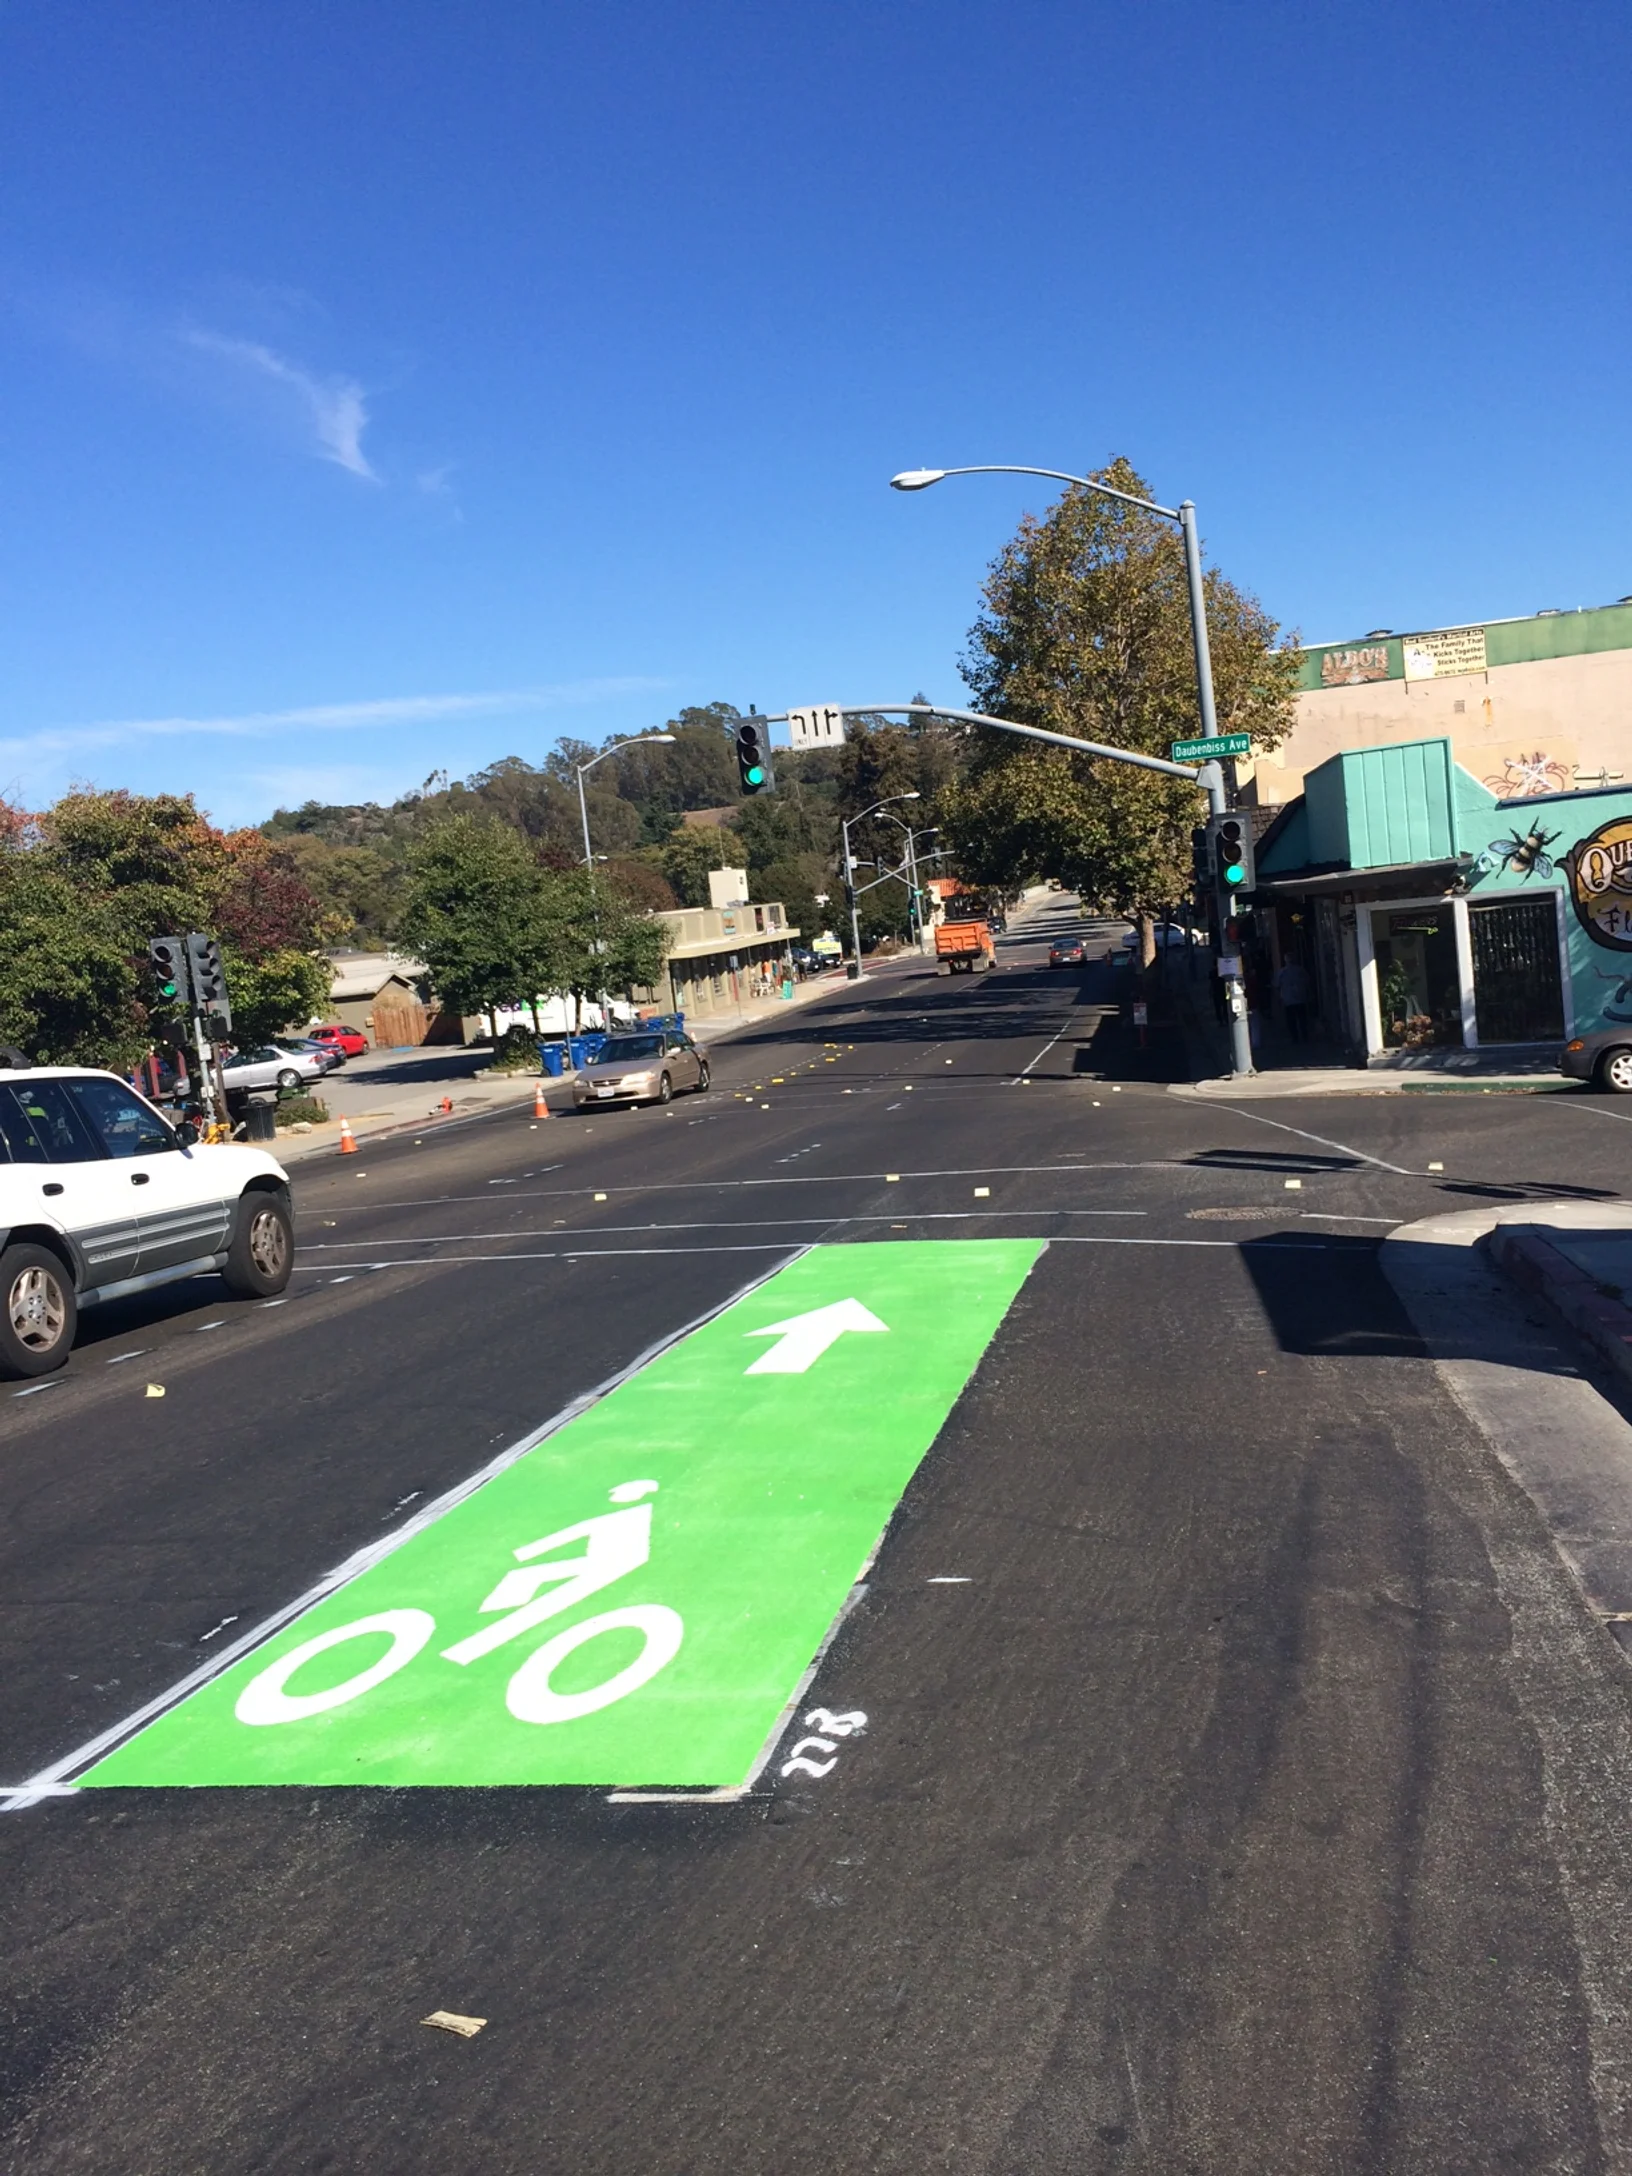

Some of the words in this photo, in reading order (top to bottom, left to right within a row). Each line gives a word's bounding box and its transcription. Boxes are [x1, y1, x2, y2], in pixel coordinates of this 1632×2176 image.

[1425, 643, 1439, 651] The
[1441, 639, 1465, 649] Family
[1467, 637, 1484, 645] That
[1433, 650, 1452, 658] Kicks
[1454, 647, 1484, 656] Together
[1437, 658, 1456, 666] Sticks
[1457, 654, 1484, 663] Together
[1175, 741, 1226, 757] Daubenbiss
[1229, 739, 1247, 750] Ave
